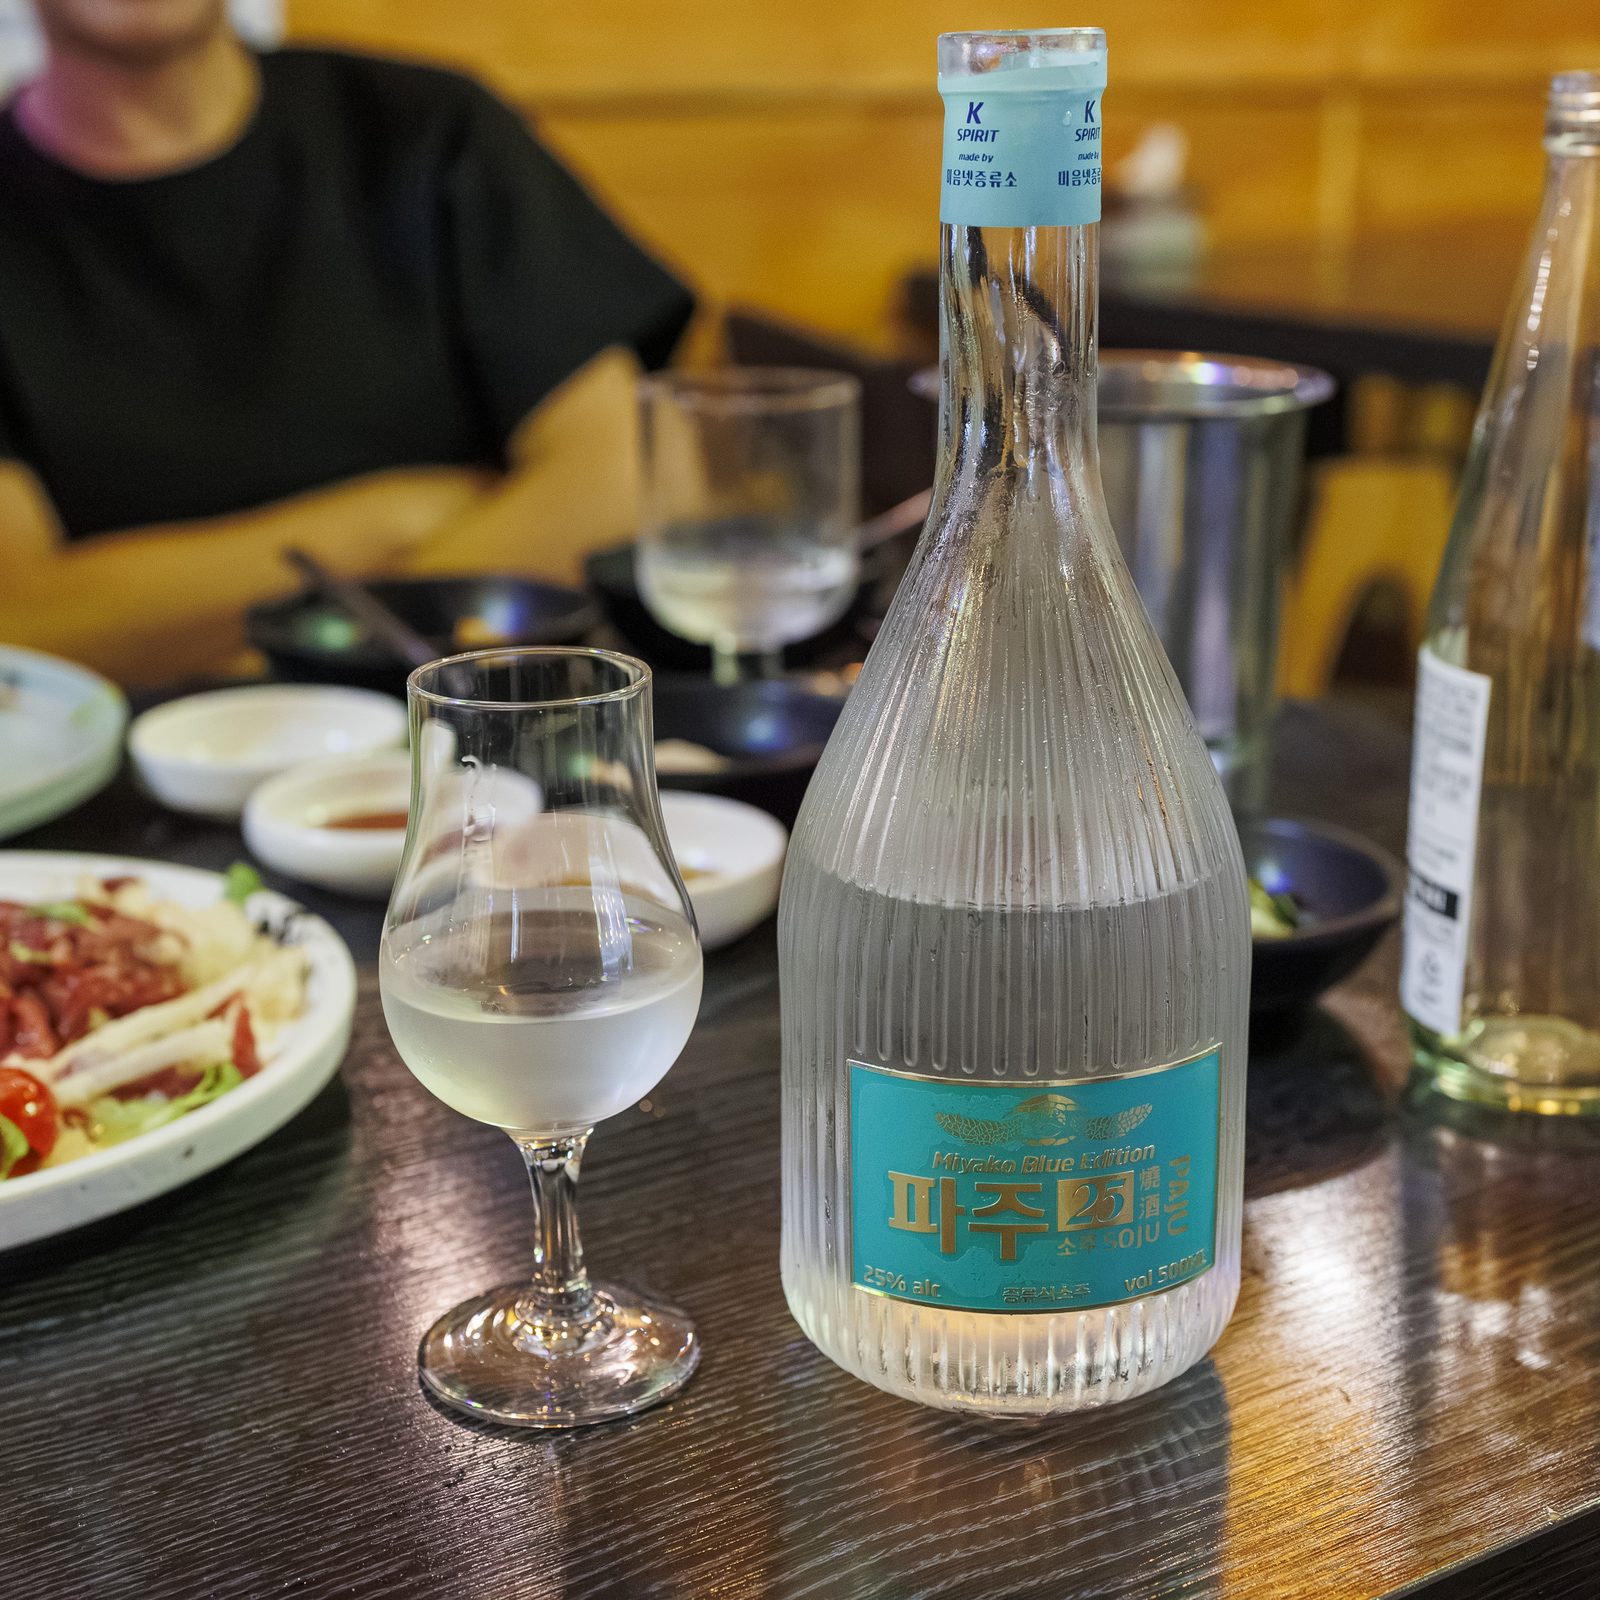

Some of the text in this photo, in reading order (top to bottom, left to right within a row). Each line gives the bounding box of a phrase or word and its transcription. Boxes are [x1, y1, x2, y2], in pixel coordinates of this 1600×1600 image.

[966, 101, 985, 125] K
[1084, 100, 1096, 123] K
[957, 128, 1000, 143] SPIRIT
[1074, 127, 1101, 142] SPIRIT
[958, 153, 994, 164] made by
[946, 168, 1018, 188] 미음넷증류소
[932, 1143, 1156, 1175] Miyako Blue Edition
[1164, 1154, 1192, 1237] PAJU
[887, 1170, 1127, 1261] 파주 25
[1103, 1221, 1161, 1251] SOJU
[863, 1264, 943, 1298] 25% alc
[1002, 1283, 1091, 1305] 증류식소주
